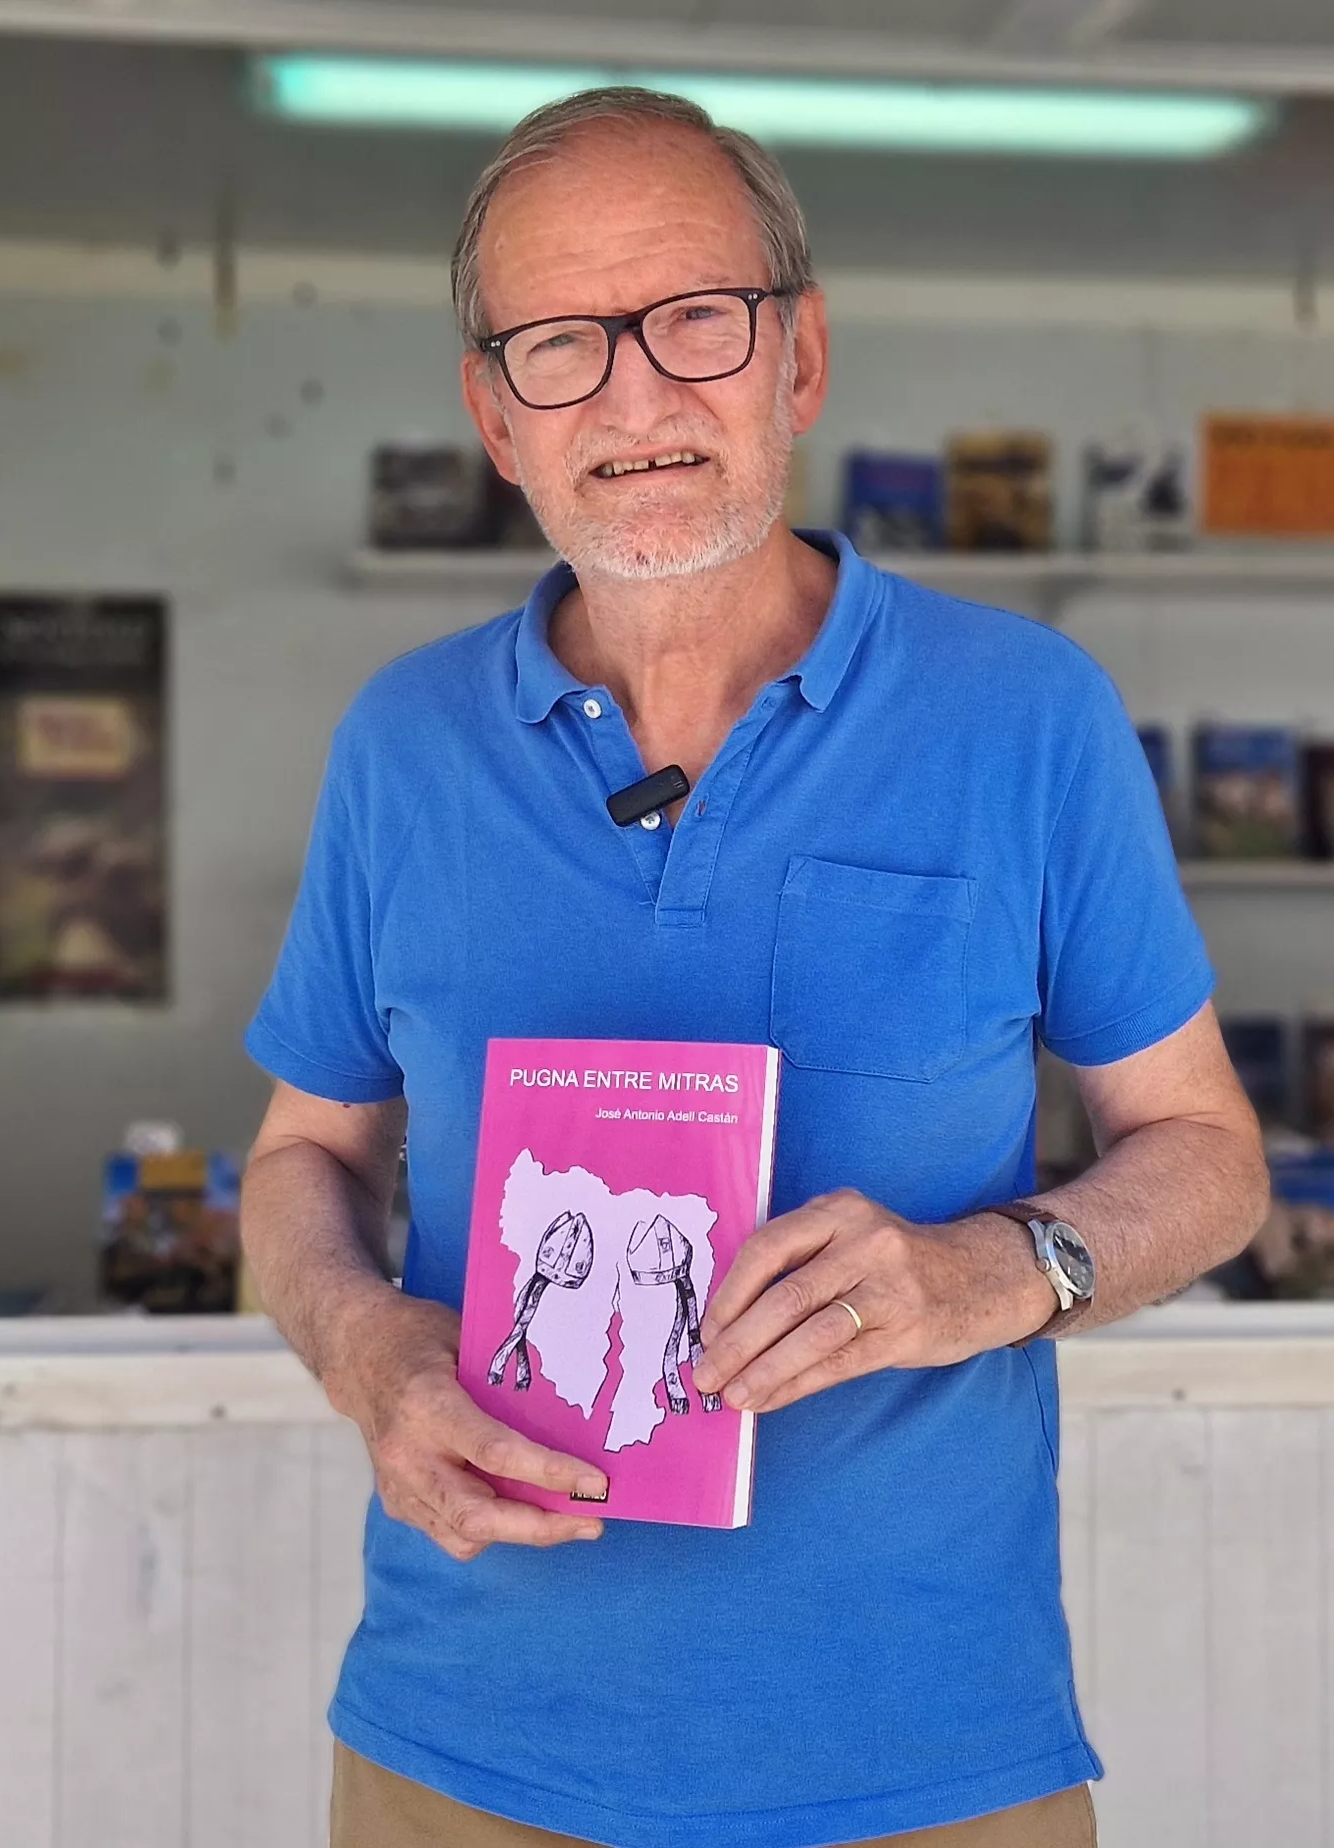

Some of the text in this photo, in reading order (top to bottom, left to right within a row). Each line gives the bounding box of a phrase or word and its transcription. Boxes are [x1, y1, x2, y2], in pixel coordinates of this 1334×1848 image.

[510, 1068, 739, 1093] PUGNA ENTRE MITRAS
[595, 1107, 738, 1124] José Antonio Adell Castán
